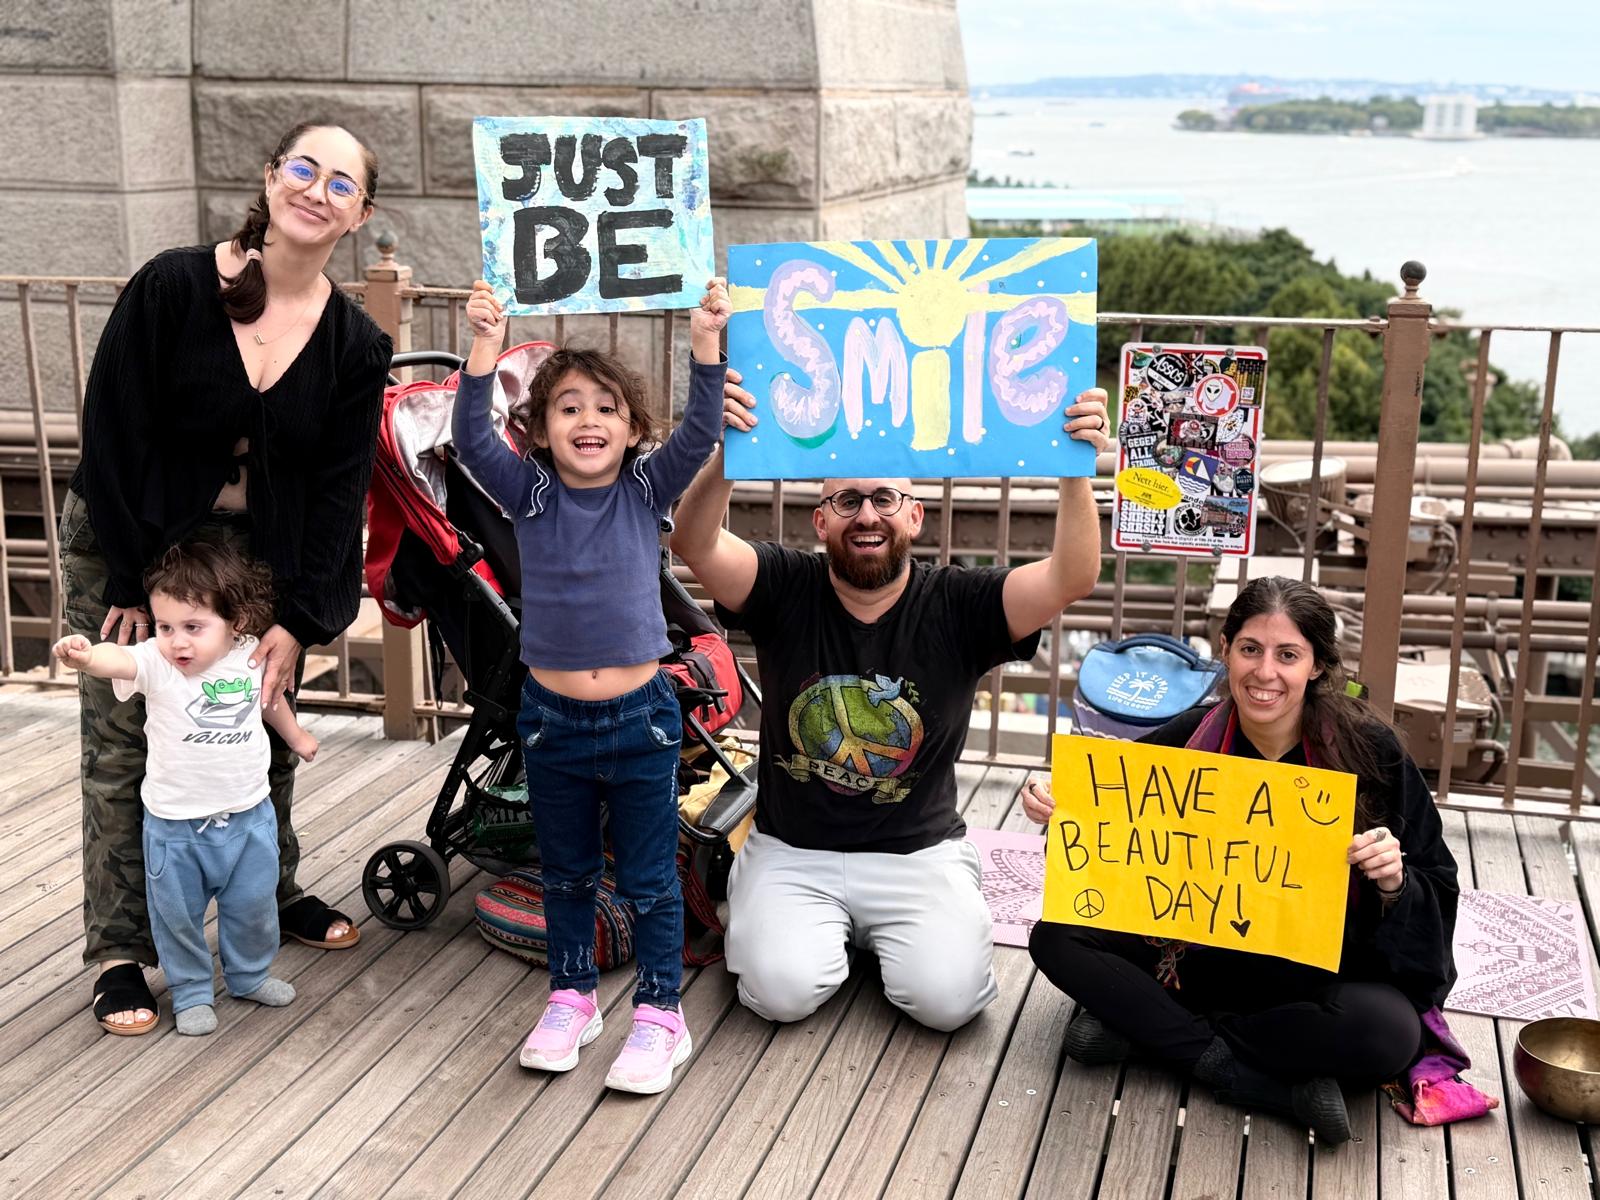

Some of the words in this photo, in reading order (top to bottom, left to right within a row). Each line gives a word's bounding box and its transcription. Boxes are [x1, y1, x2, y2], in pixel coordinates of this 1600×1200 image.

[500, 132, 688, 206] JUST
[513, 206, 683, 304] BE
[1133, 471, 1152, 486] Nett
[1110, 672, 1130, 688] KEEP
[182, 730, 253, 744] VOLCOM
[1087, 753, 1219, 823] HAVE
[1246, 781, 1274, 827] A
[1060, 820, 1303, 889] BEAUTIFUL
[1146, 875, 1251, 938] DAY!
